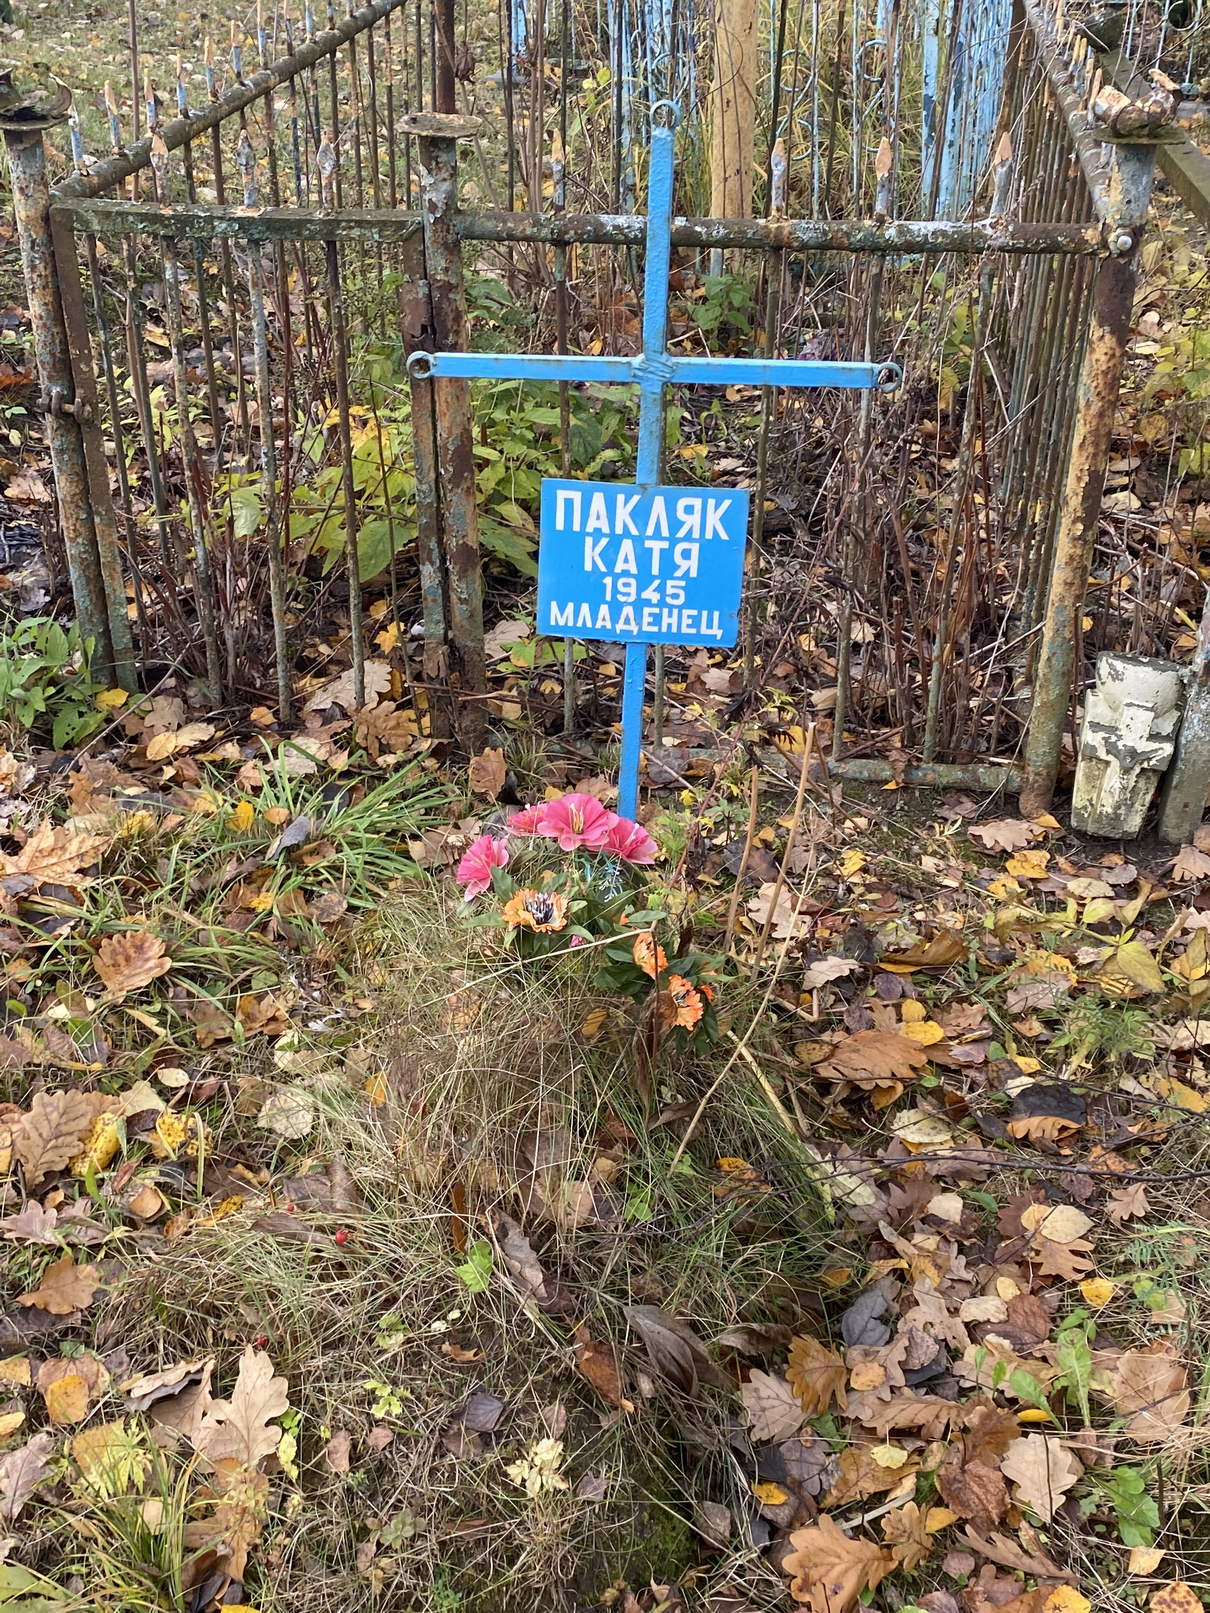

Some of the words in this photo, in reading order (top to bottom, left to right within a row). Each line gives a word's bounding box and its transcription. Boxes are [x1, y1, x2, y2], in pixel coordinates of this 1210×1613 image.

[555, 489, 732, 542] ПАКЛЯК
[584, 535, 700, 578] КАТЯ
[602, 576, 686, 606] 1945
[549, 600, 723, 640] МЛАДЕНЕЦ
